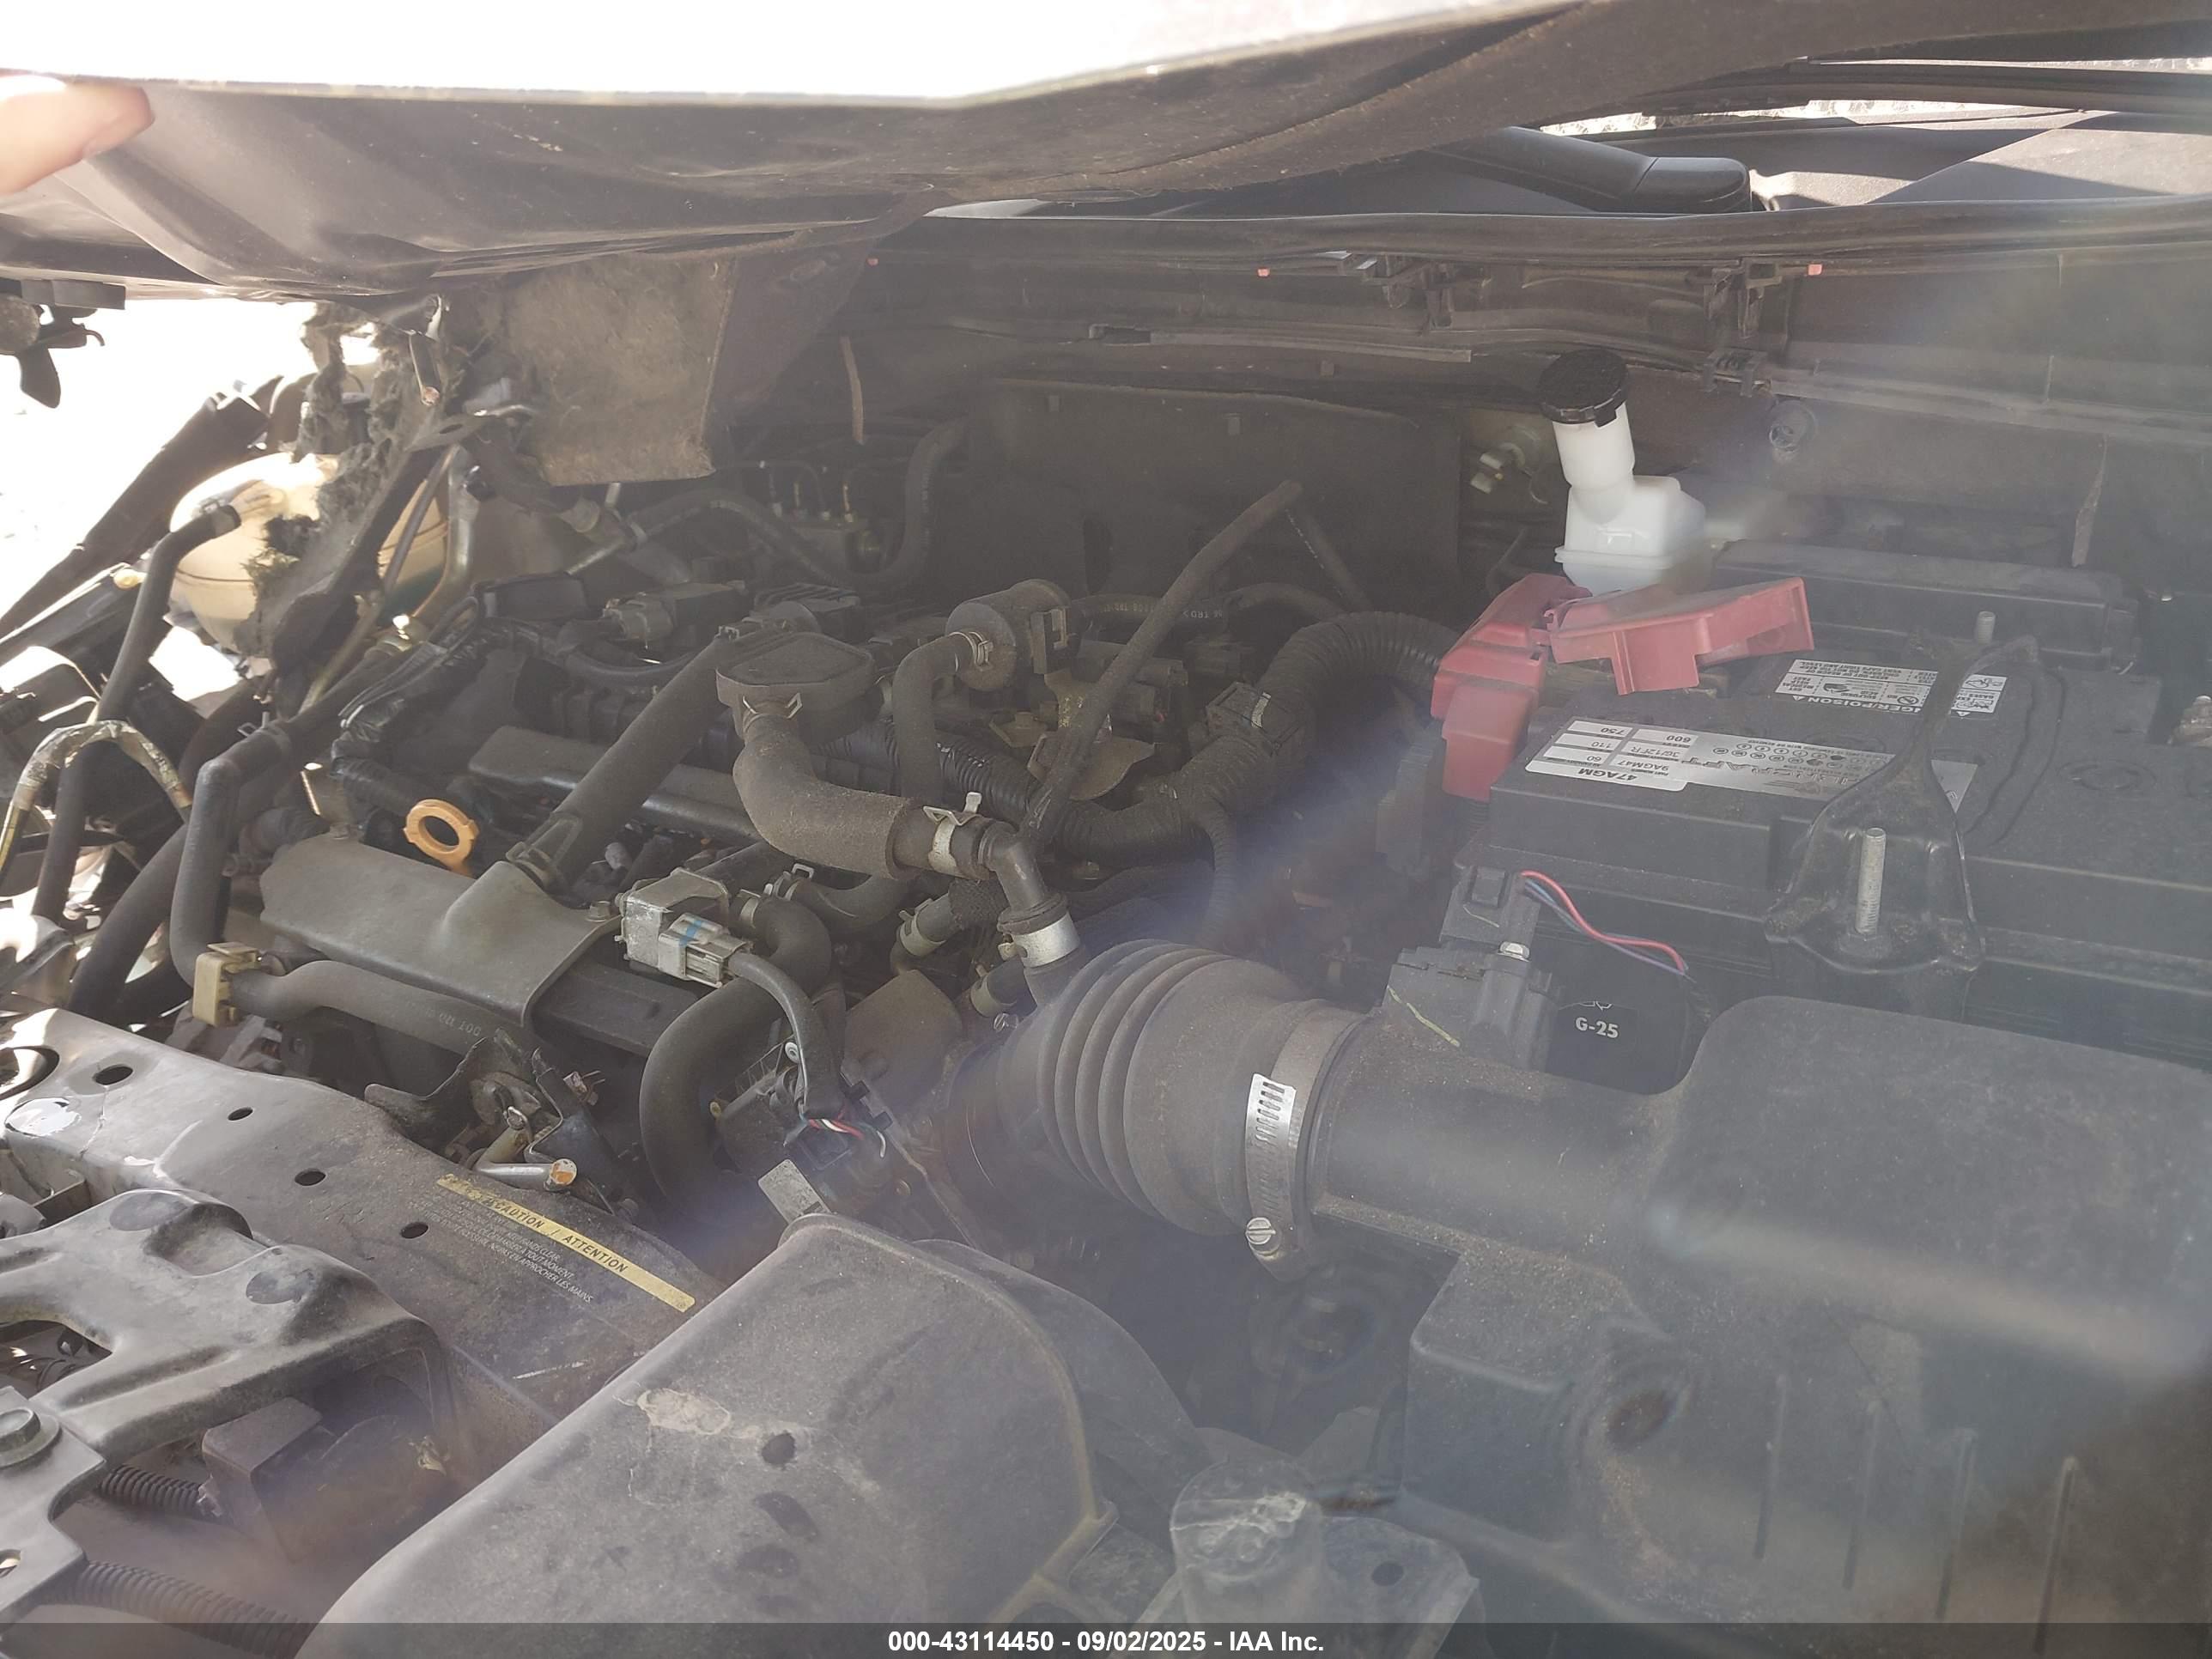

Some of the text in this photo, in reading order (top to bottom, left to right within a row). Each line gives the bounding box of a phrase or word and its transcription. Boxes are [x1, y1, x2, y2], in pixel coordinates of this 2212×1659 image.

[1601, 727, 1626, 736] 750
[1666, 735, 1692, 744] 600
[1617, 761, 1670, 771] 9AGM47
[1578, 768, 1638, 781] 47AGM
[1575, 1017, 1620, 1039] G-25
[495, 1200, 544, 1229] CAUTION
[562, 1234, 629, 1273] ATTENTION
[520, 1257, 559, 1282] APPROCHER
